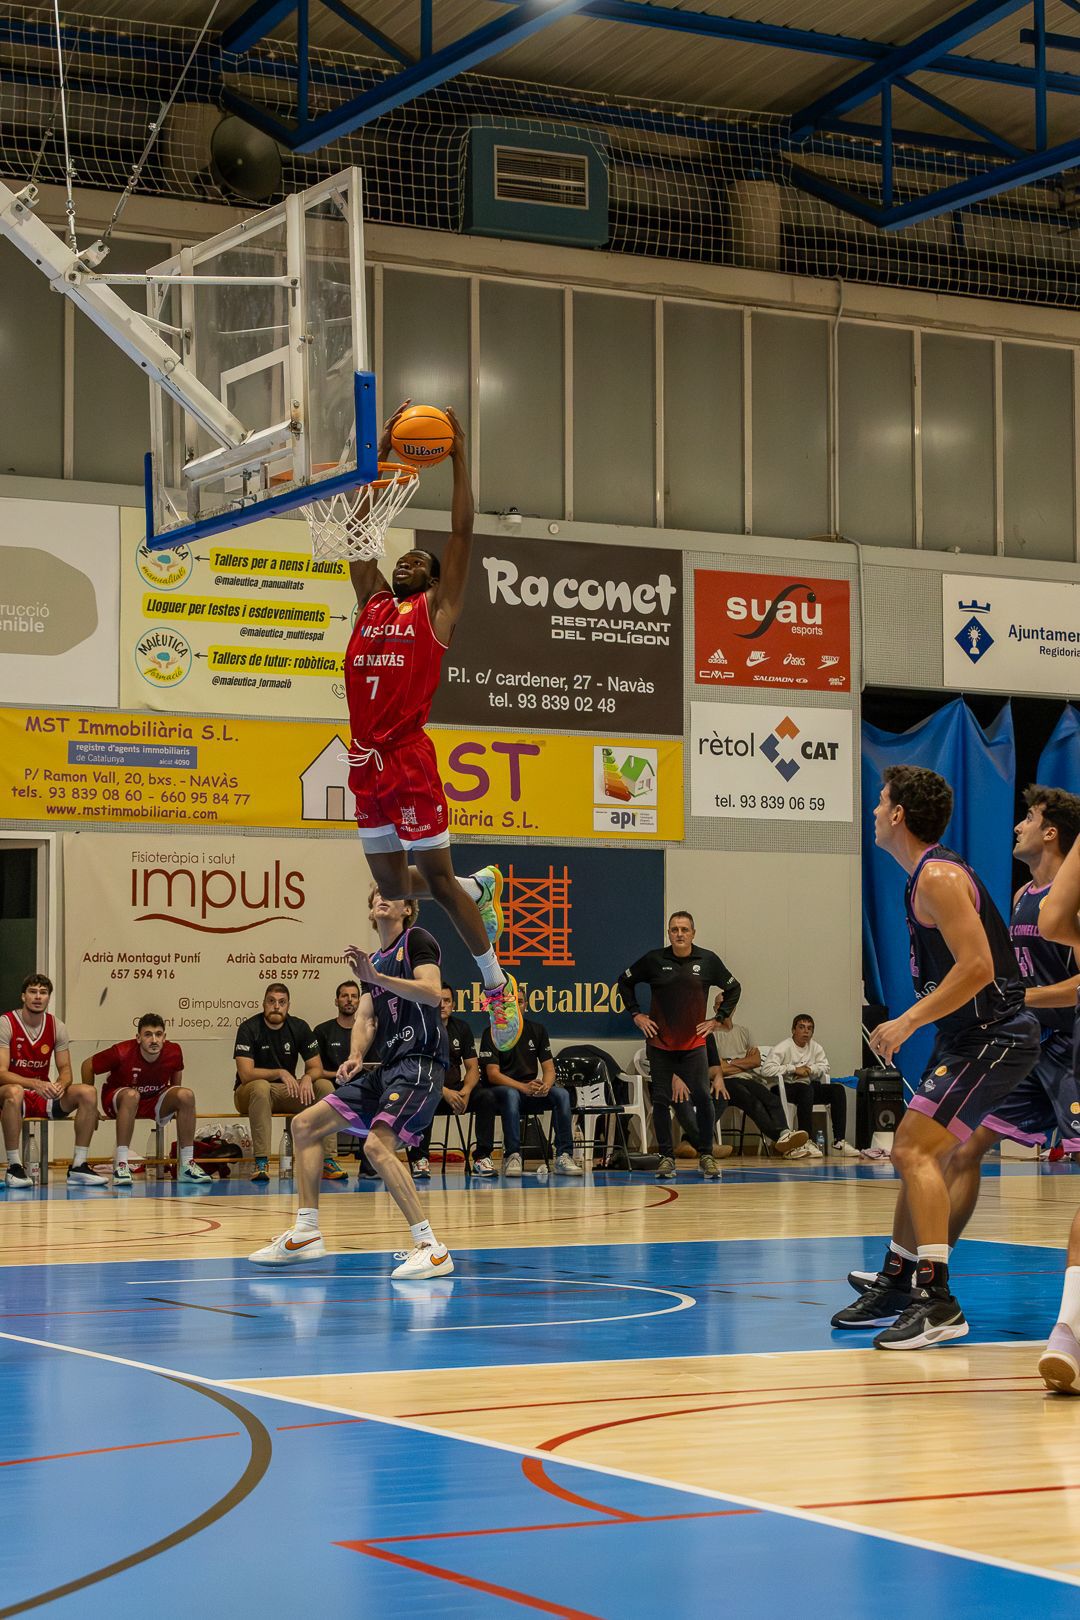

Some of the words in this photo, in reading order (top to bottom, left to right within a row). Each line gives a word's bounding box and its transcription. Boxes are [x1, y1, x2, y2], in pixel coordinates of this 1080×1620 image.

[403, 443, 445, 456] Wilson
[214, 553, 249, 568] Tallers
[250, 558, 269, 570] per
[270, 560, 277, 570] a
[279, 560, 304, 572] nens
[305, 559, 311, 572] i
[311, 561, 346, 575] adults.
[214, 575, 305, 591] @maieutica_manualitats
[482, 556, 677, 616] Raconet
[0, 601, 49, 617] rucció
[147, 599, 187, 614] Lloguer
[188, 603, 206, 616] per
[207, 603, 240, 617] festes
[241, 604, 247, 617] i
[248, 605, 326, 623] esdeveniments
[726, 596, 823, 626] suau
[551, 615, 672, 632] RESTAURANT
[791, 624, 824, 637] esports
[239, 627, 325, 641] @maieutica_multiespai
[551, 629, 586, 642] DEL
[591, 630, 670, 646] POLÍGON
[138, 632, 189, 658] MAIÈUTICA
[212, 651, 247, 666] Tallers
[249, 653, 262, 666] de
[263, 655, 292, 668] futur:
[293, 656, 339, 672] robòtica,
[750, 650, 766, 660] NIKE
[475, 668, 492, 685] c/
[495, 670, 569, 692] cardener,
[573, 674, 592, 690] 27
[607, 676, 655, 694] Navàs
[699, 670, 735, 679] CMP
[752, 674, 795, 684] SALOMON
[366, 675, 380, 700] 7
[488, 691, 512, 708] tel.
[517, 693, 537, 709] 93
[541, 694, 570, 711] 839
[574, 695, 594, 712] 02
[597, 698, 616, 713] 48
[25, 716, 70, 733] MST
[78, 718, 193, 739] Immobiliària
[201, 724, 239, 742] S.L.
[76, 743, 106, 753] registre
[107, 744, 140, 755] d'agents
[142, 745, 190, 756] immobiliaris
[699, 730, 755, 757] rètol
[800, 741, 839, 761] CAT
[87, 753, 125, 764] Catalunya
[24, 768, 39, 781] P/
[43, 769, 88, 783] Ramon
[93, 771, 120, 786] Vall,
[124, 772, 144, 787] 20,
[148, 773, 176, 787] bxs.
[190, 772, 239, 789] NAVÀS
[443, 741, 541, 802] ST
[11, 785, 42, 799] tels.
[48, 787, 66, 799] 93
[71, 787, 98, 801] 839
[102, 788, 120, 801] 08
[125, 789, 142, 802] 60
[160, 790, 187, 803] 660
[190, 792, 208, 804] 95
[212, 793, 230, 805] 84
[234, 793, 251, 806] 77
[715, 794, 736, 808] tel.
[740, 795, 756, 809] 93
[760, 795, 785, 810] 839
[789, 796, 806, 811] 06
[809, 797, 825, 811] 59
[46, 804, 218, 820] www.mstimmobiliaria.com
[449, 807, 494, 828] liària
[501, 810, 539, 830] S.L.
[610, 811, 637, 829] api
[131, 851, 199, 866] Fisioteràpia
[202, 852, 206, 864] i
[208, 853, 236, 865] salut
[131, 860, 306, 919] impuls
[83, 951, 114, 963] Adrià
[117, 952, 171, 966] Montagut
[174, 951, 201, 964] Puntí
[226, 952, 256, 964] Adrià
[259, 953, 298, 964] Sabata
[110, 969, 130, 979] 657
[133, 969, 153, 979] 594
[156, 969, 175, 979] 916
[258, 969, 278, 980] 658
[280, 969, 299, 980] 559
[302, 969, 320, 980] 772
[191, 998, 260, 1011] impulsnavas
[178, 1016, 214, 1029] Josep,
[217, 1016, 232, 1028] 22,
